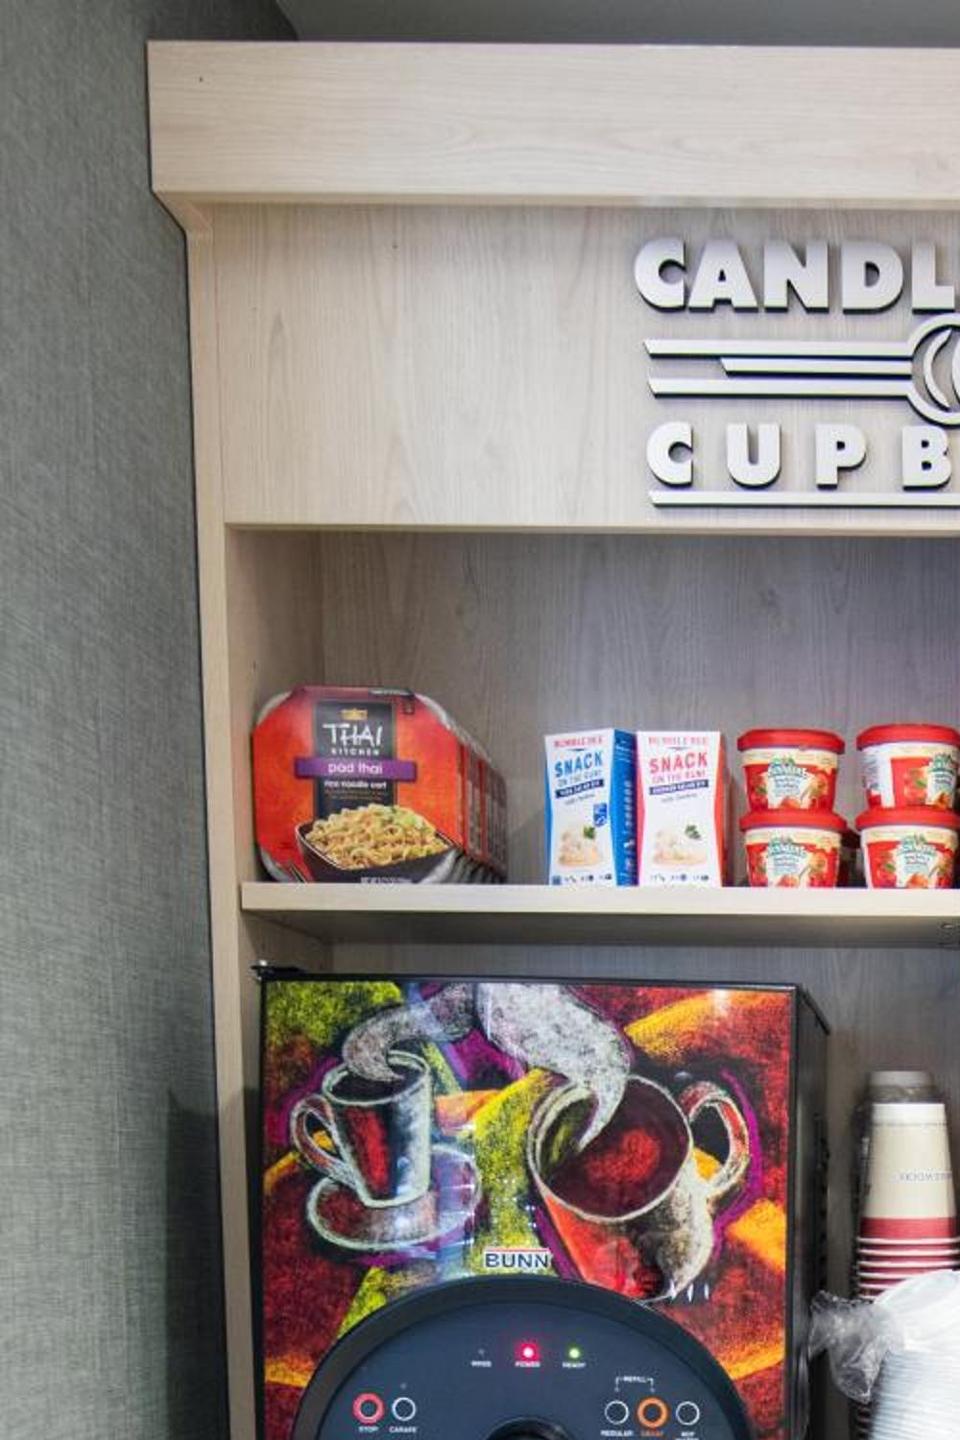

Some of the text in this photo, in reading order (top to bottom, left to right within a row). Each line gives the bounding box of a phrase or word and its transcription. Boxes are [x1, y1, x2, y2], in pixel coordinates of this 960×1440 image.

[323, 723, 383, 748] THAI
[328, 762, 384, 776] pad thai
[554, 751, 603, 778] SNACK
[649, 751, 708, 774] SNACK
[485, 1253, 549, 1268] BUNN
